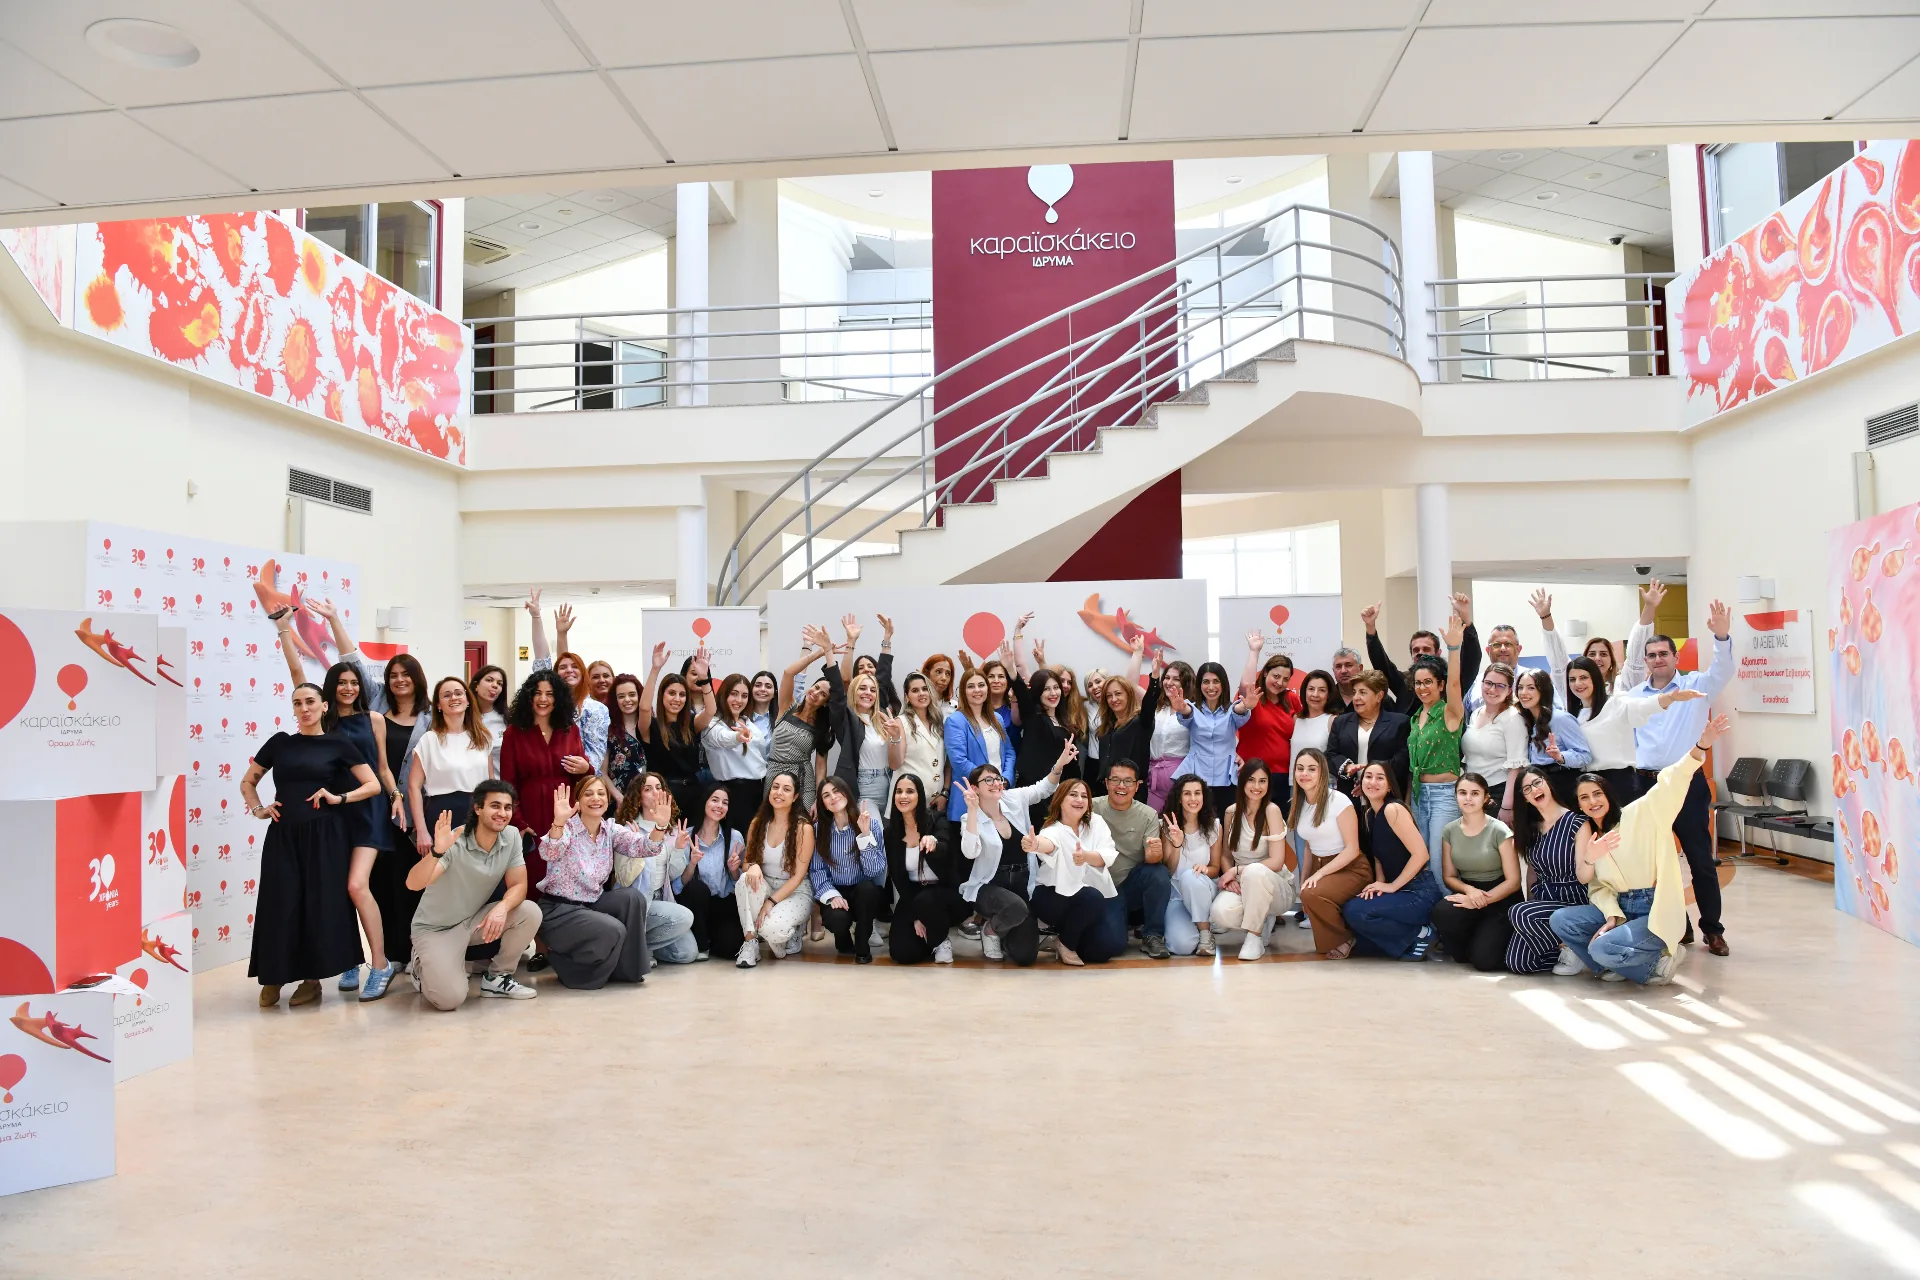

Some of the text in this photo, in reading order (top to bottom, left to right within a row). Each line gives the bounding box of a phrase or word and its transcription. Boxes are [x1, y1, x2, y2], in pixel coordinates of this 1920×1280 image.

[970, 228, 1136, 259] καραϊσκάκειο
[1032, 256, 1074, 267] ΙΔΡΥΜΑ
[20, 713, 121, 731] καραϊσκάκειο
[89, 853, 116, 902] 30
[106, 900, 119, 911] years
[0, 1102, 69, 1121] σκάκειο
[0, 1121, 22, 1129] ΔΡΥΜΑ
[14, 1130, 37, 1140] Ζωής
